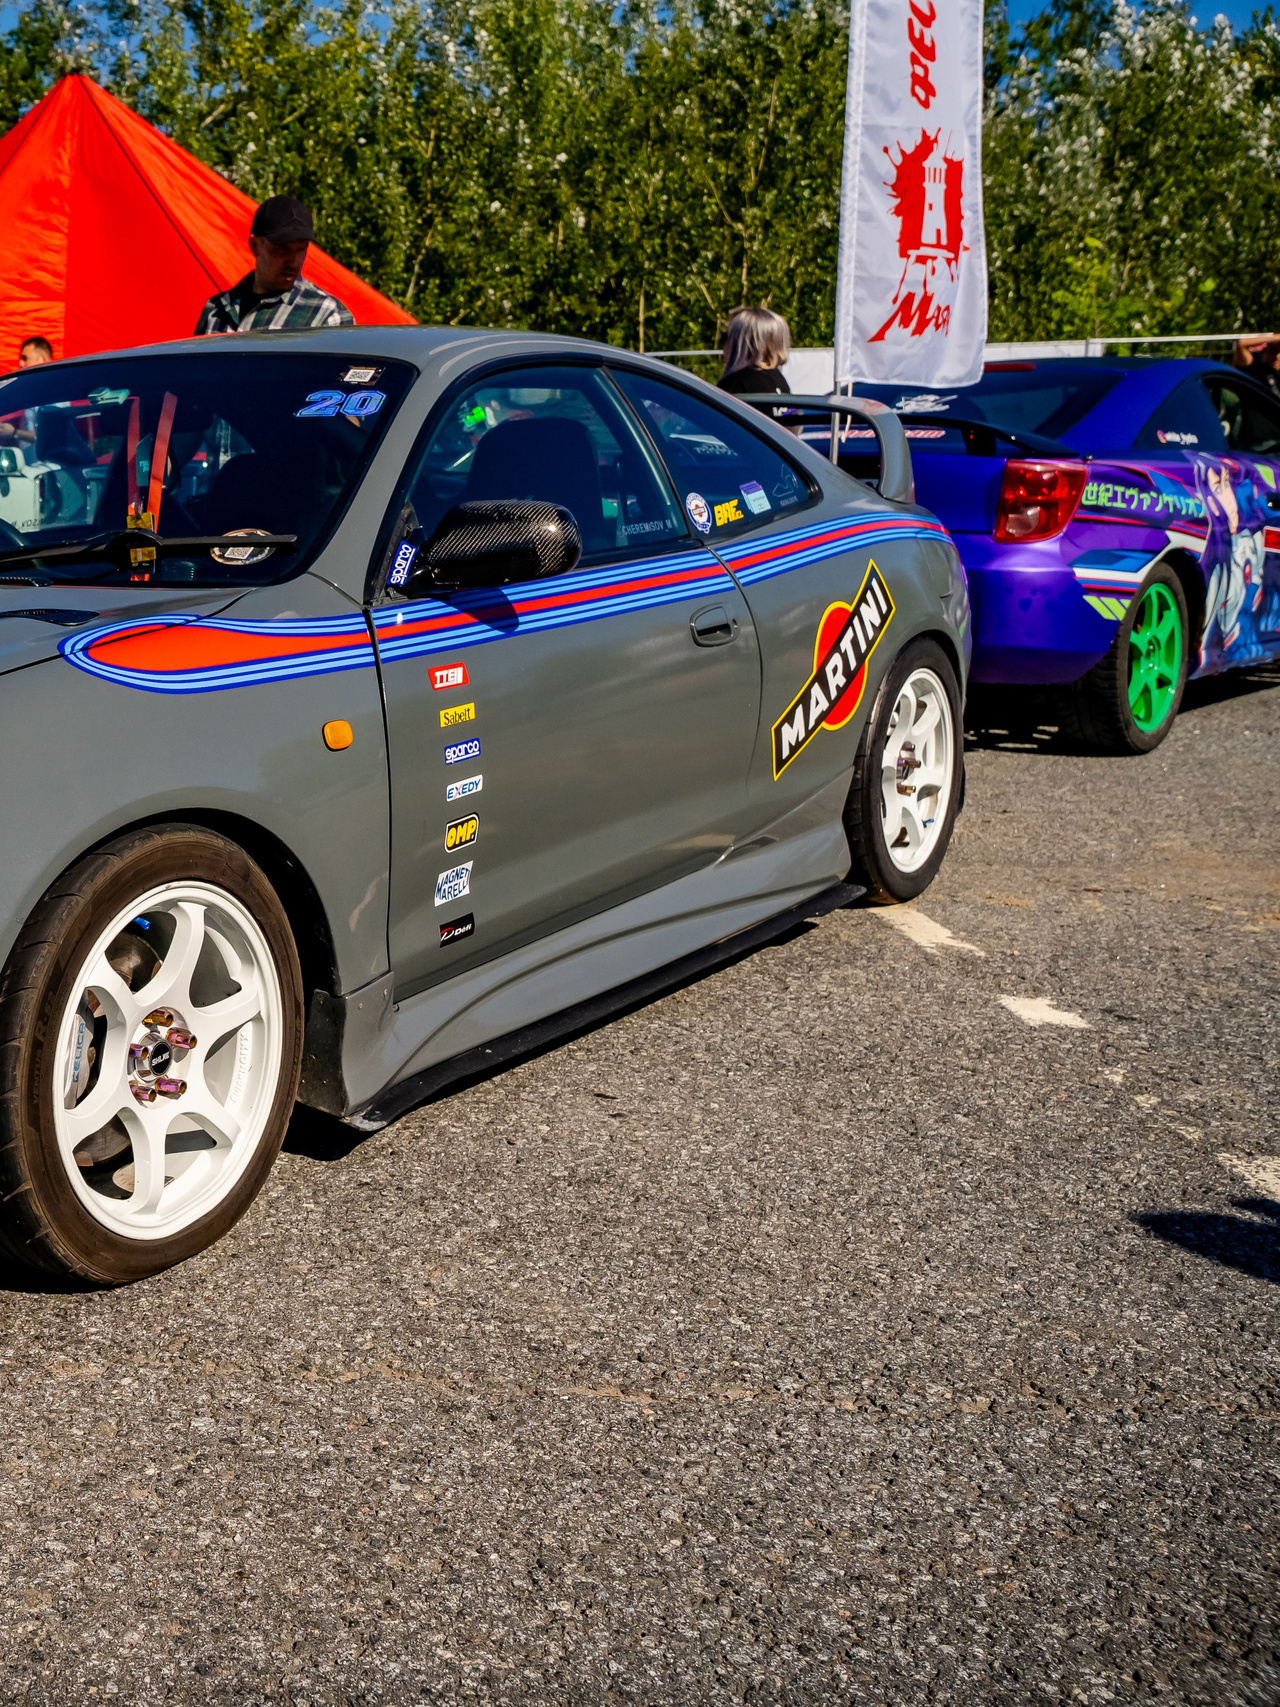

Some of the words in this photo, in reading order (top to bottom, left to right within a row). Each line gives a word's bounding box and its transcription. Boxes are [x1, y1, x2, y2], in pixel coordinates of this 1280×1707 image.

[296, 390, 386, 417] 20
[390, 544, 414, 585] sparco
[781, 577, 888, 760] MARTINI
[443, 707, 471, 726] Sabelt
[445, 740, 480, 763] sparco
[447, 778, 481, 799] EXEDY
[446, 818, 477, 848] OMP
